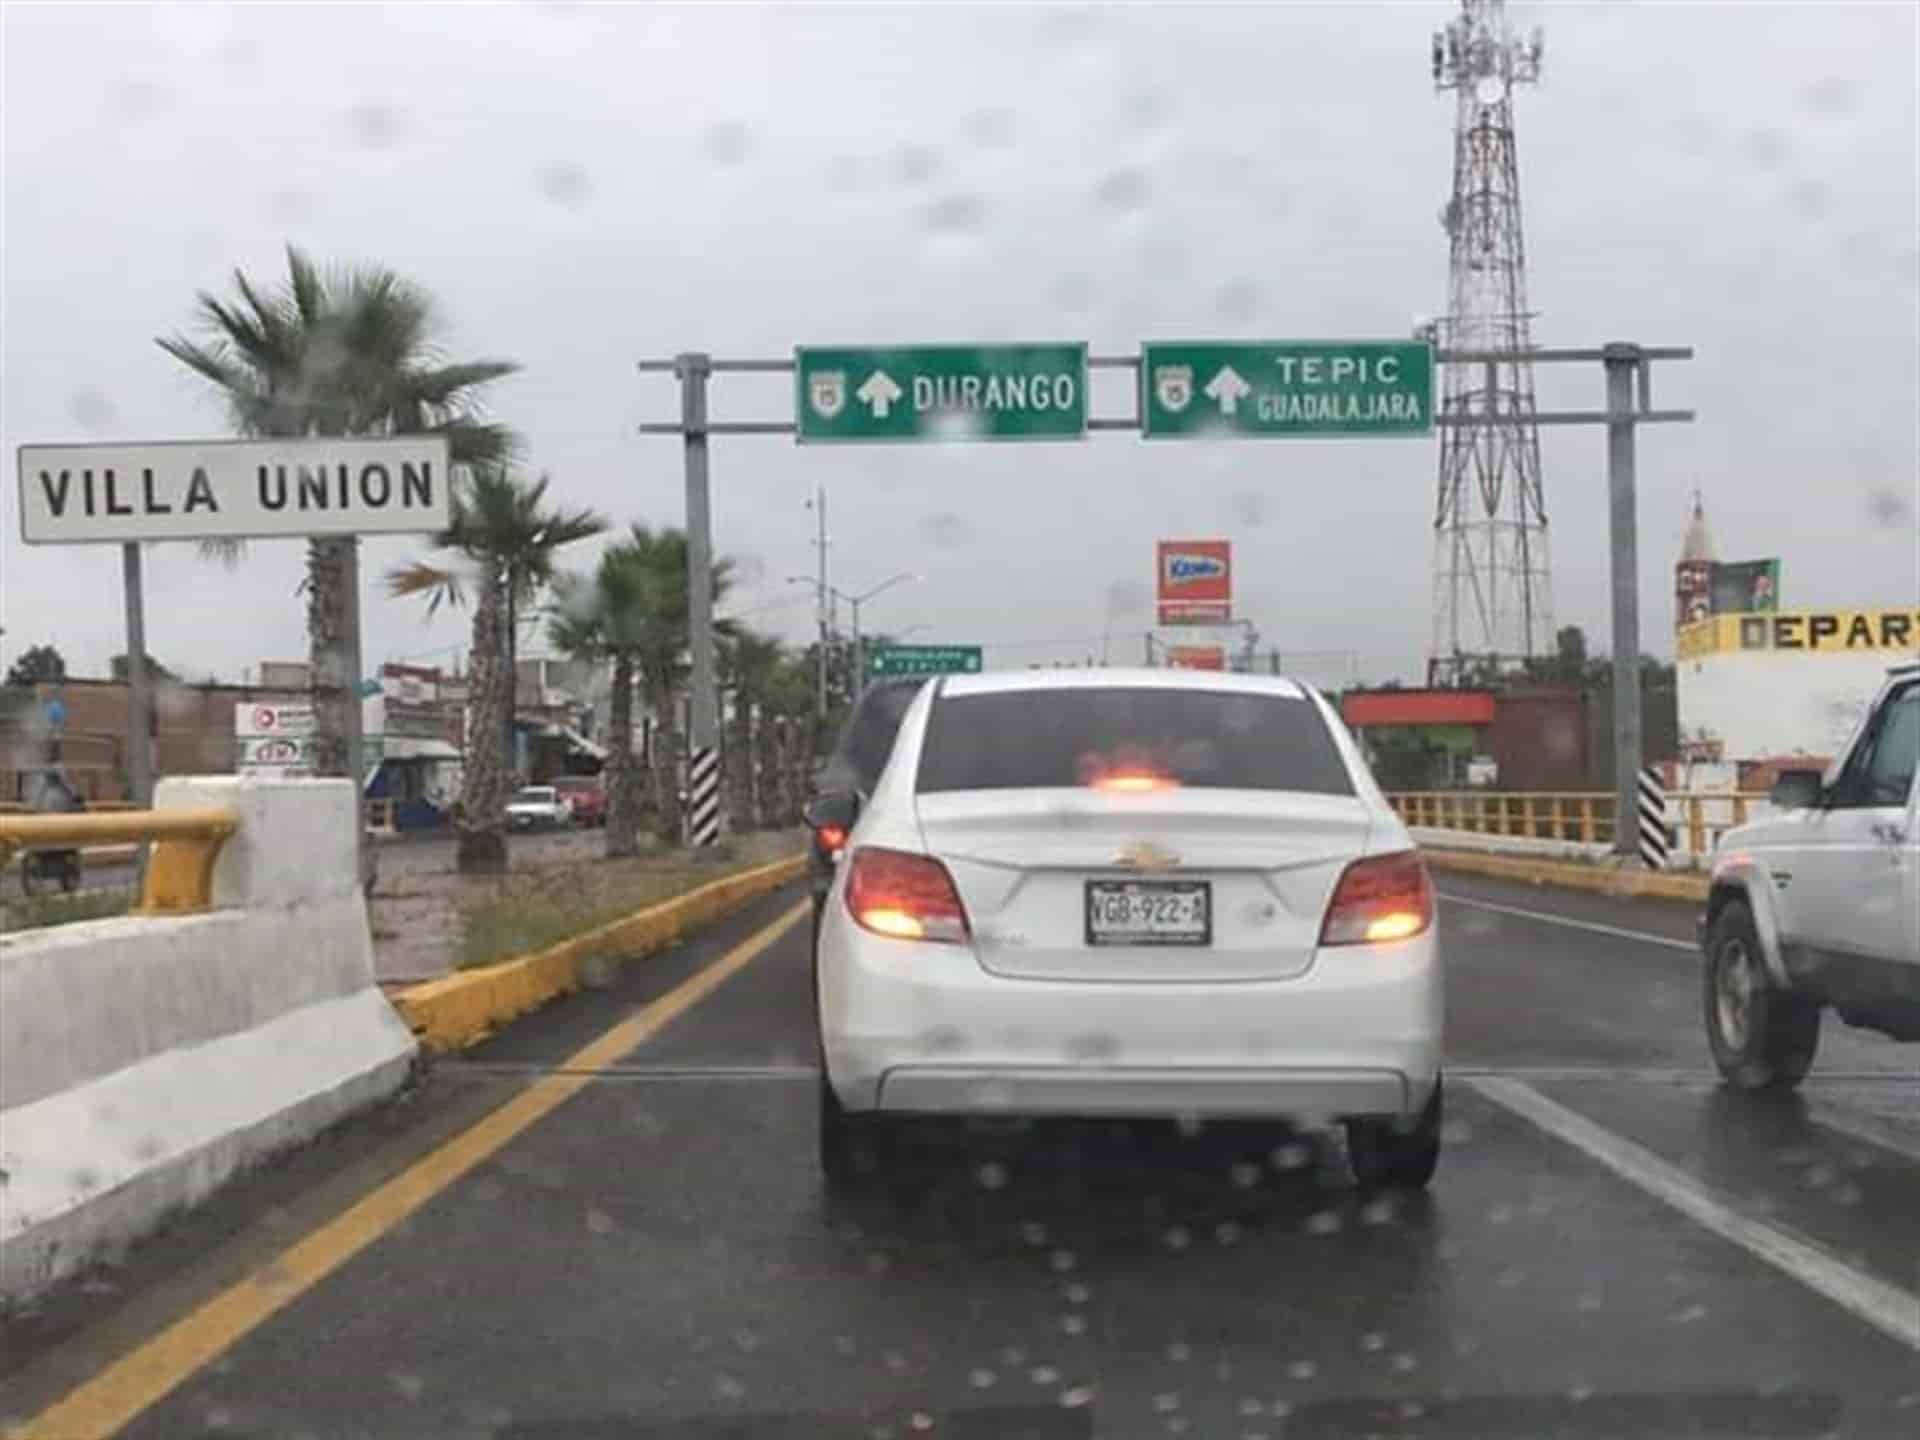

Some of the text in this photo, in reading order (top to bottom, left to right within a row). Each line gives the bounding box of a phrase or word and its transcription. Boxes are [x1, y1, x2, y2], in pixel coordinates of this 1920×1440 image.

[1276, 356, 1400, 384] TEPIC
[913, 373, 1074, 411] DURANGO
[1257, 393, 1421, 423] GUADALAJARA
[39, 461, 434, 517] VILLA UNION
[1741, 613, 1920, 649] DEPAR
